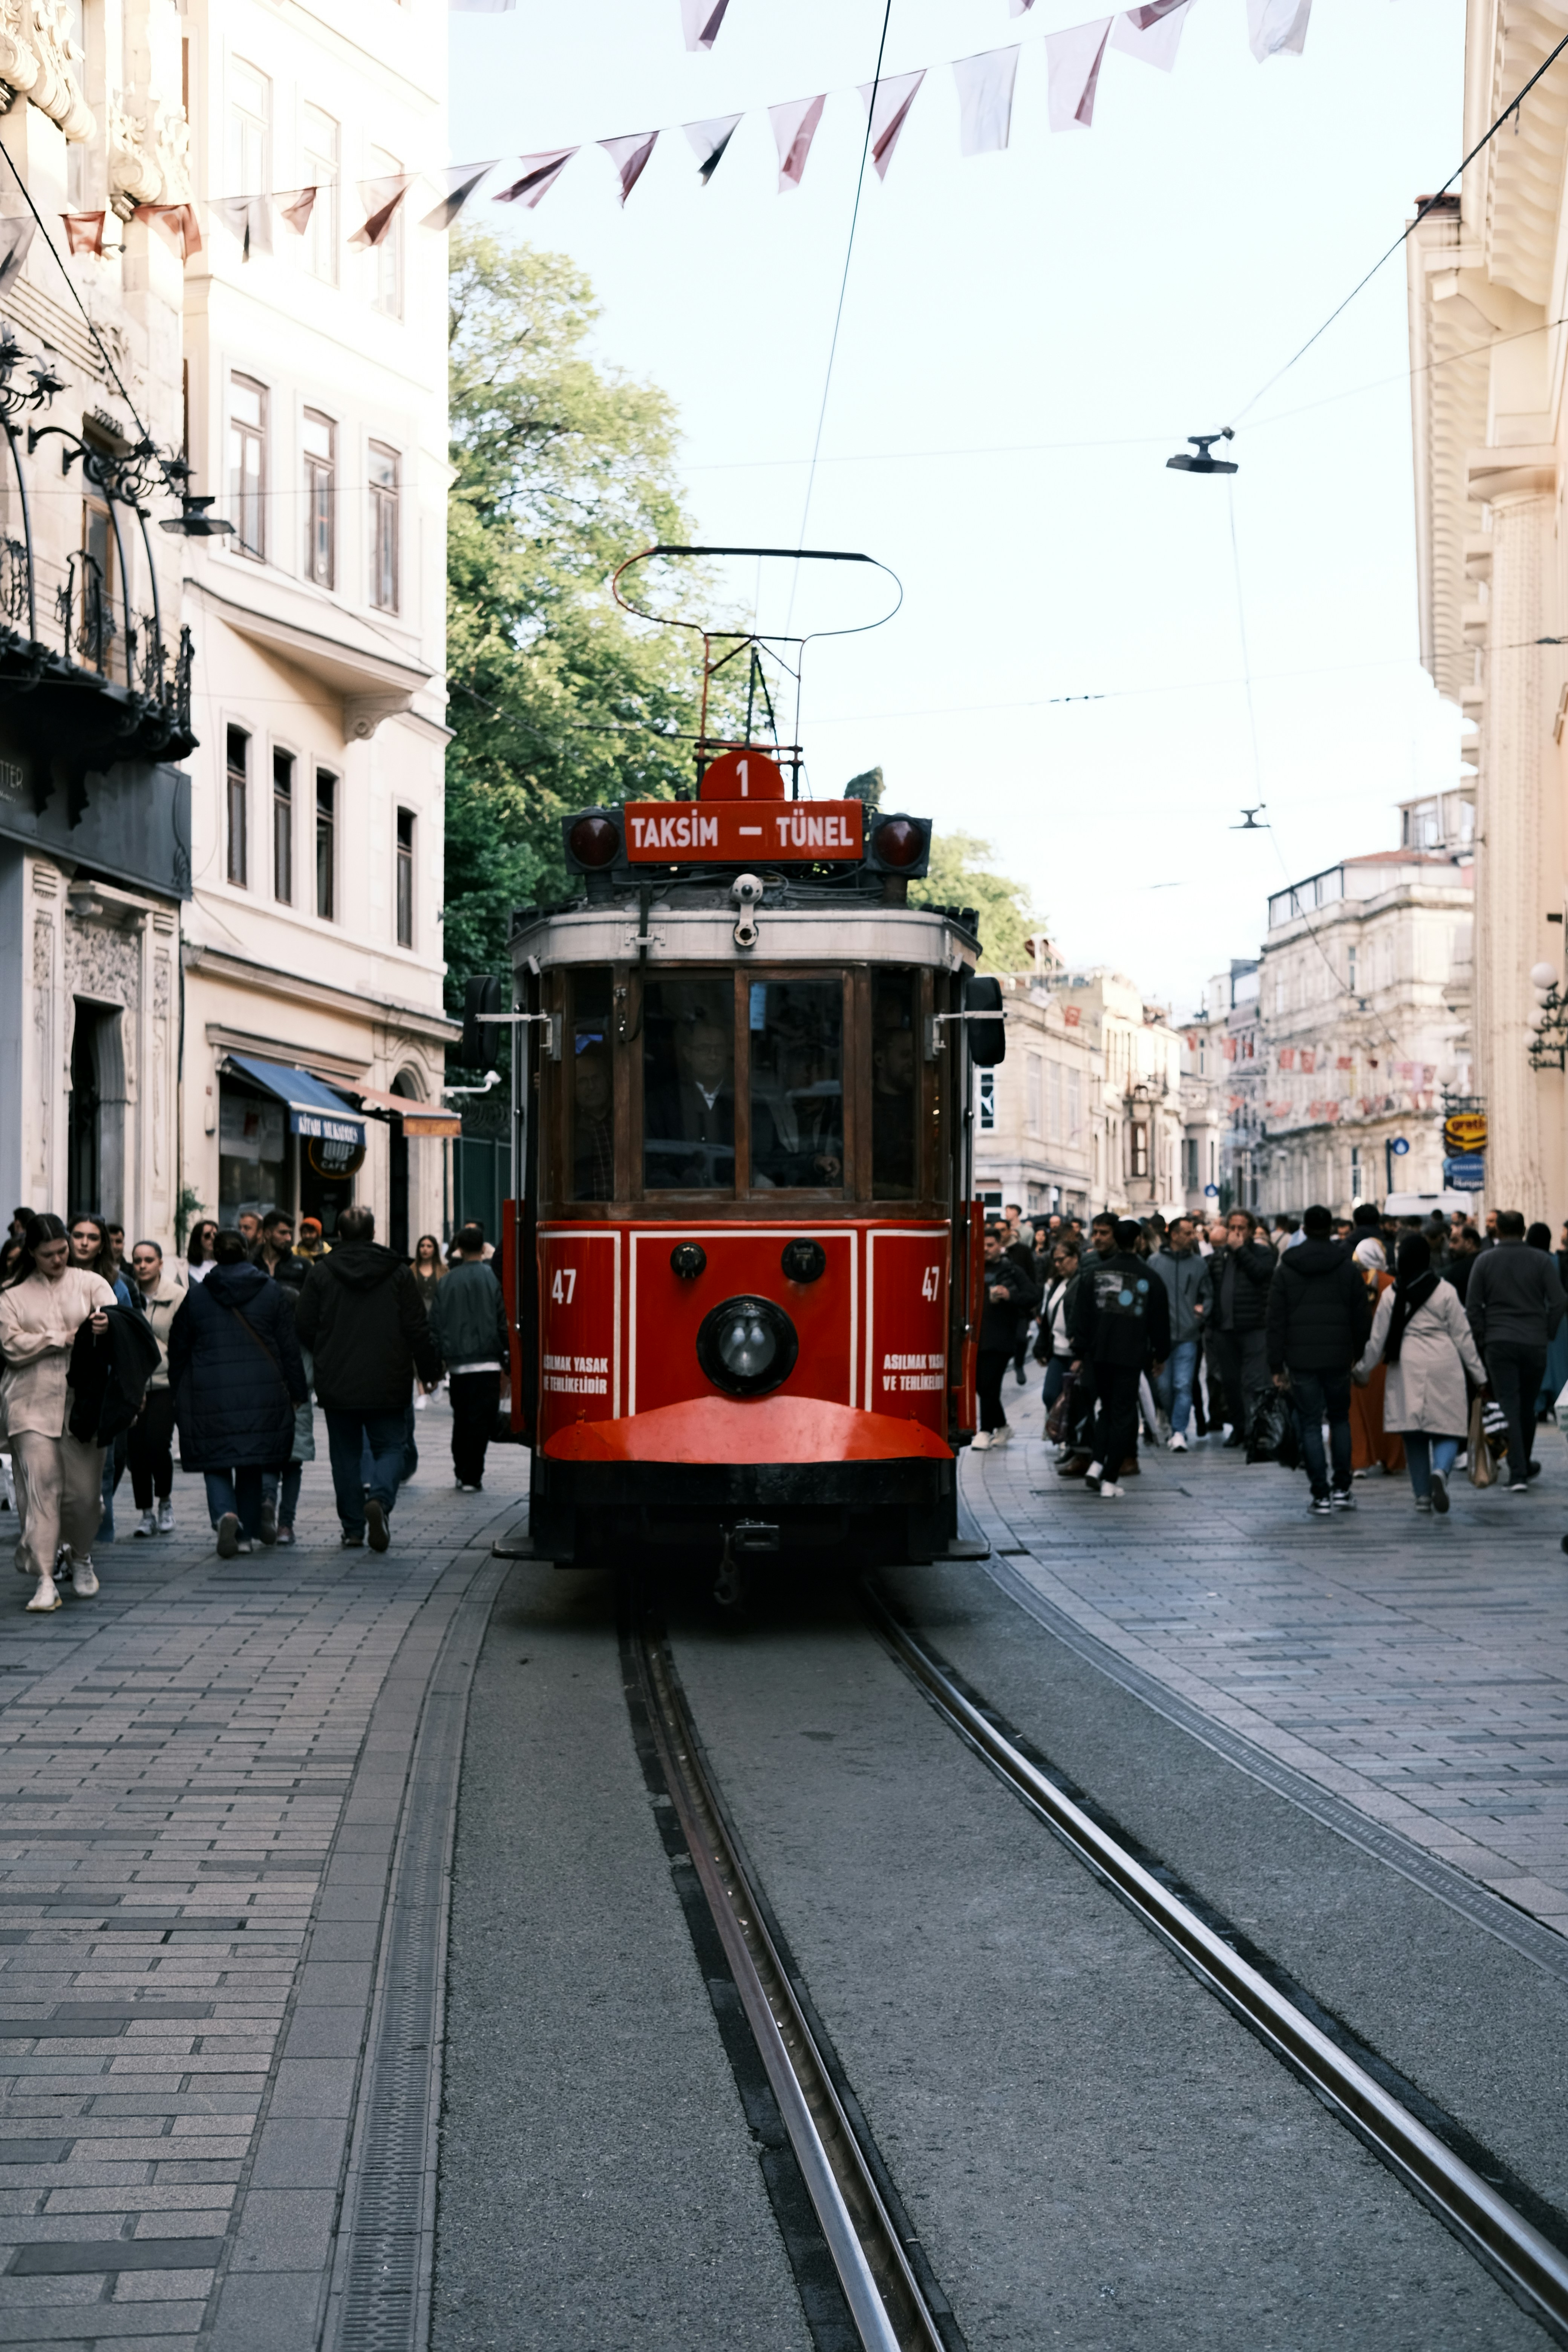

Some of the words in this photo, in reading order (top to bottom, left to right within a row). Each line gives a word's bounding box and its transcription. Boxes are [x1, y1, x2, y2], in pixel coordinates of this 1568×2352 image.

[736, 760, 749, 797] 1
[631, 809, 718, 847] TAKSİM
[776, 809, 853, 847] TÜNEL
[552, 1269, 576, 1304] 47
[922, 1266, 940, 1302] 47
[573, 1357, 608, 1373] YASAK
[884, 1354, 927, 1370] ASILMAK
[550, 1375, 607, 1395] TEHLİKELİDİR
[883, 1375, 897, 1391] VE
